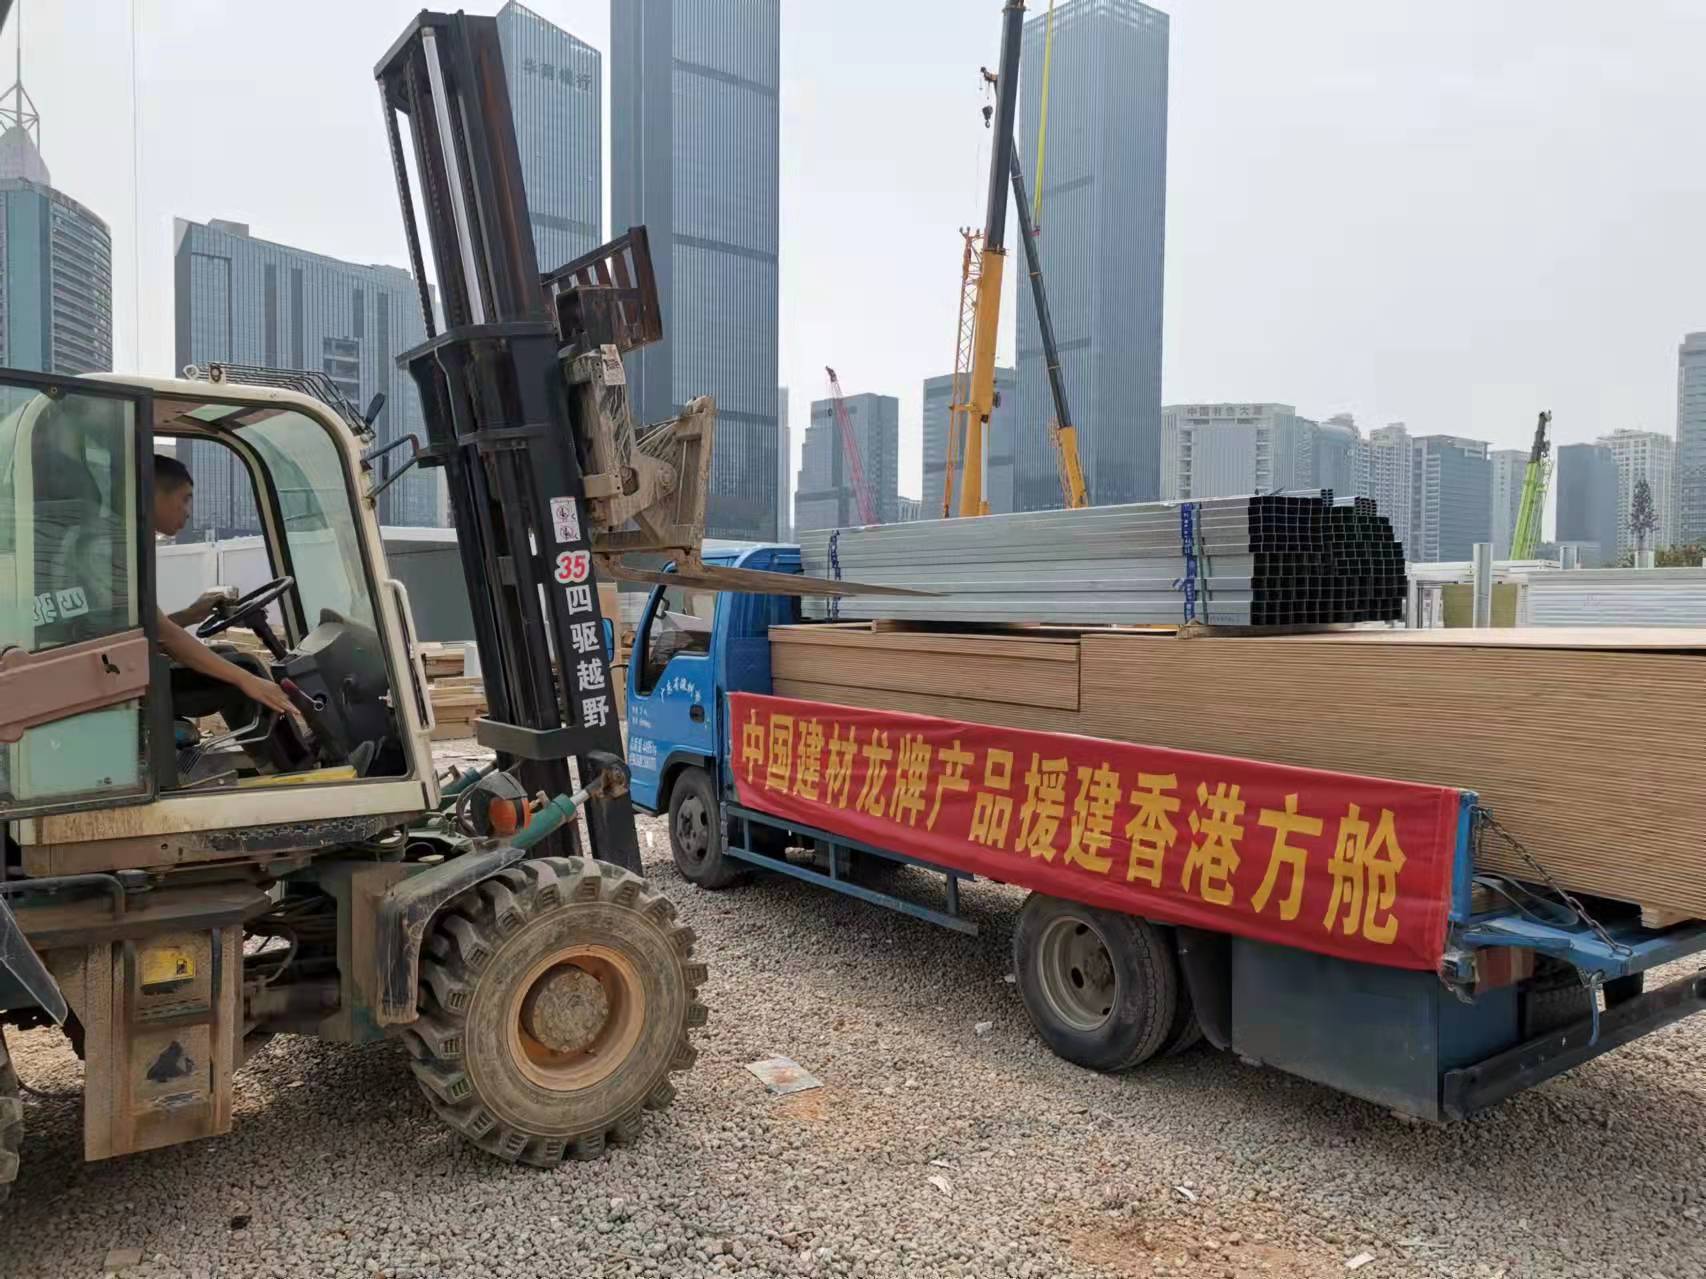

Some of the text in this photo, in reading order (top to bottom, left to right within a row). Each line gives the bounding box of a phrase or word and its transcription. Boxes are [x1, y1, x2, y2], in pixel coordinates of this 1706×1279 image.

[557, 553, 589, 582] 35
[565, 584, 610, 729] 四驱越野
[741, 708, 1407, 945] 中国建材龙牌产品援建香港方舱
